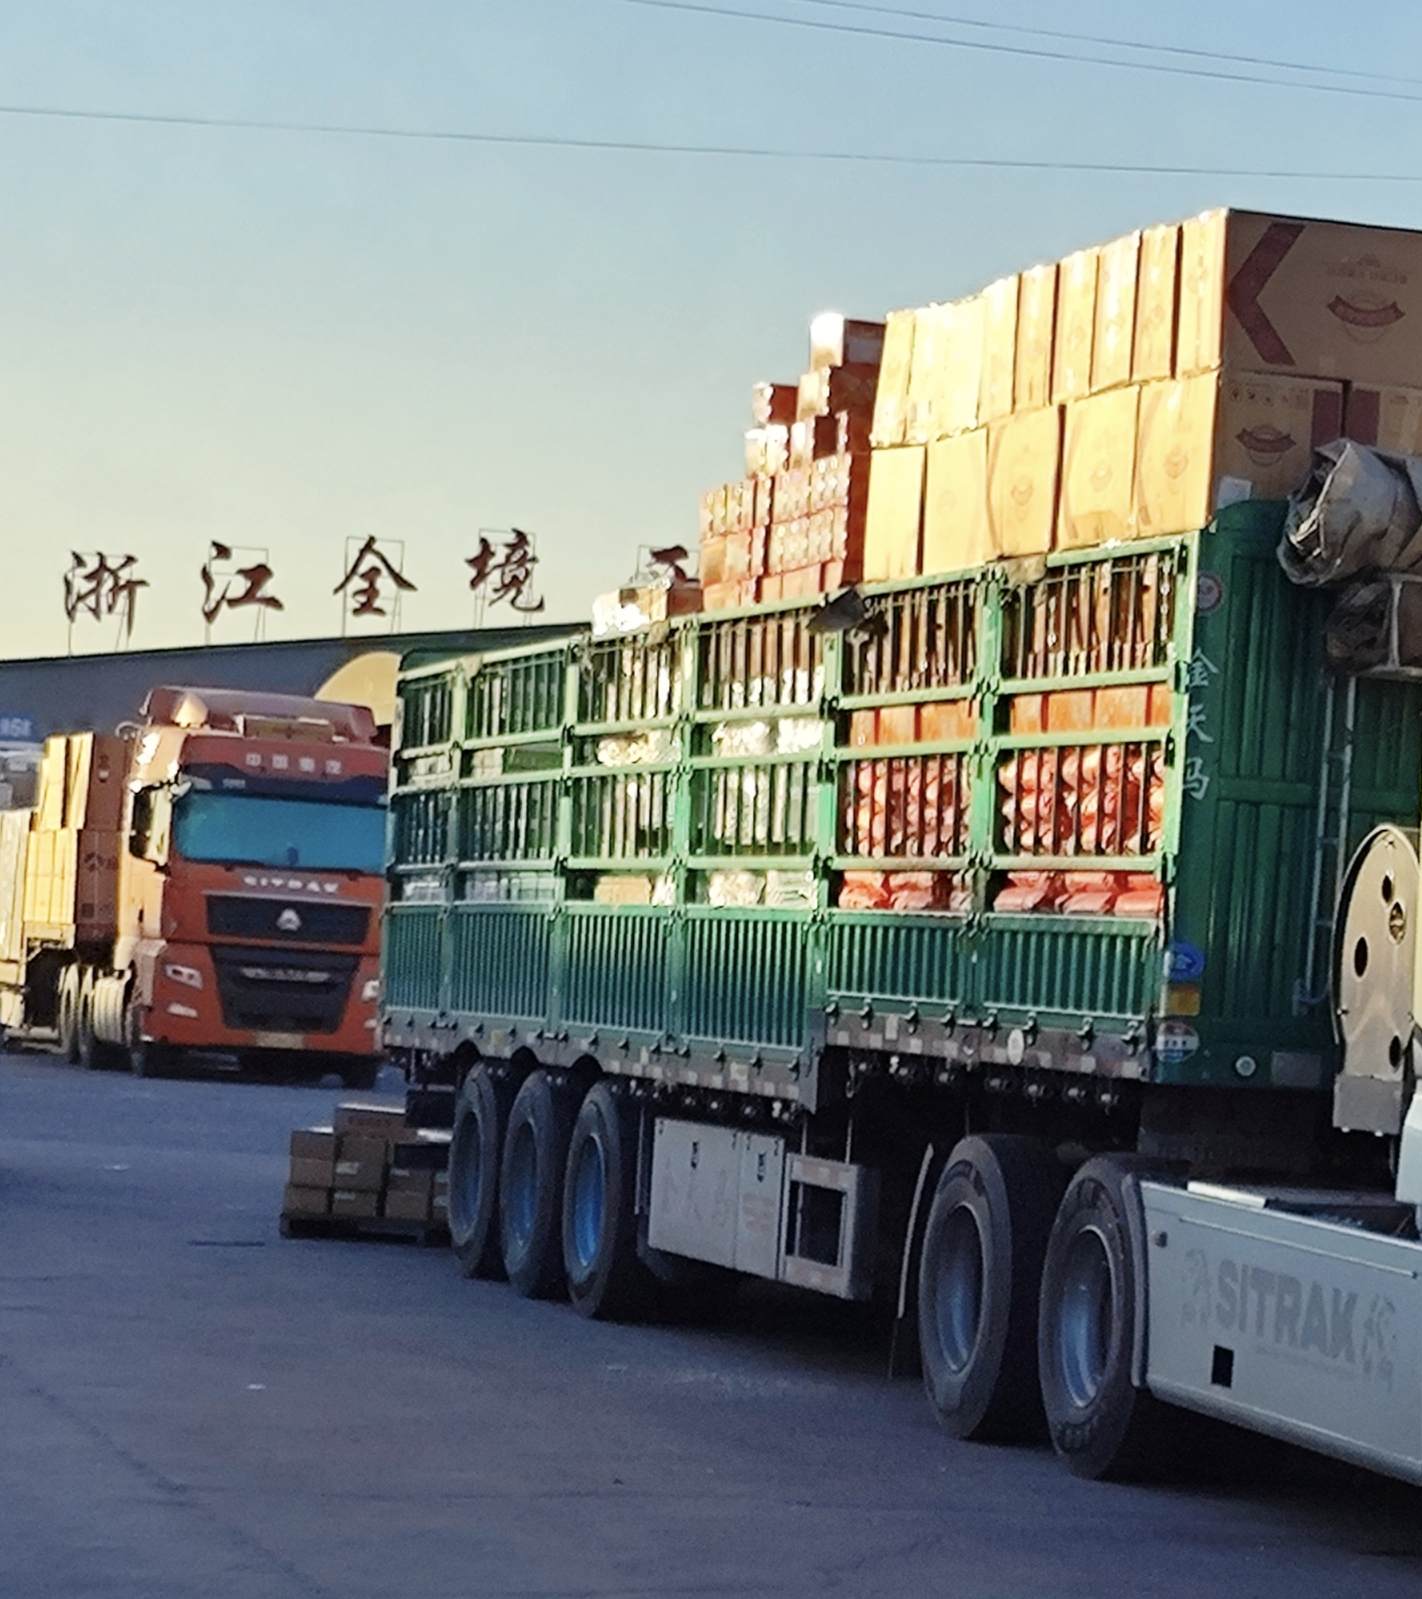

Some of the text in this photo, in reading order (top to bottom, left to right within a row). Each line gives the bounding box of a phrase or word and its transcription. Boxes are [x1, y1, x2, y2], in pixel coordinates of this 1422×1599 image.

[63, 528, 546, 637] 浙江全境
[1182, 646, 1220, 801] 金天马
[1215, 1259, 1360, 1364] SITRAK
